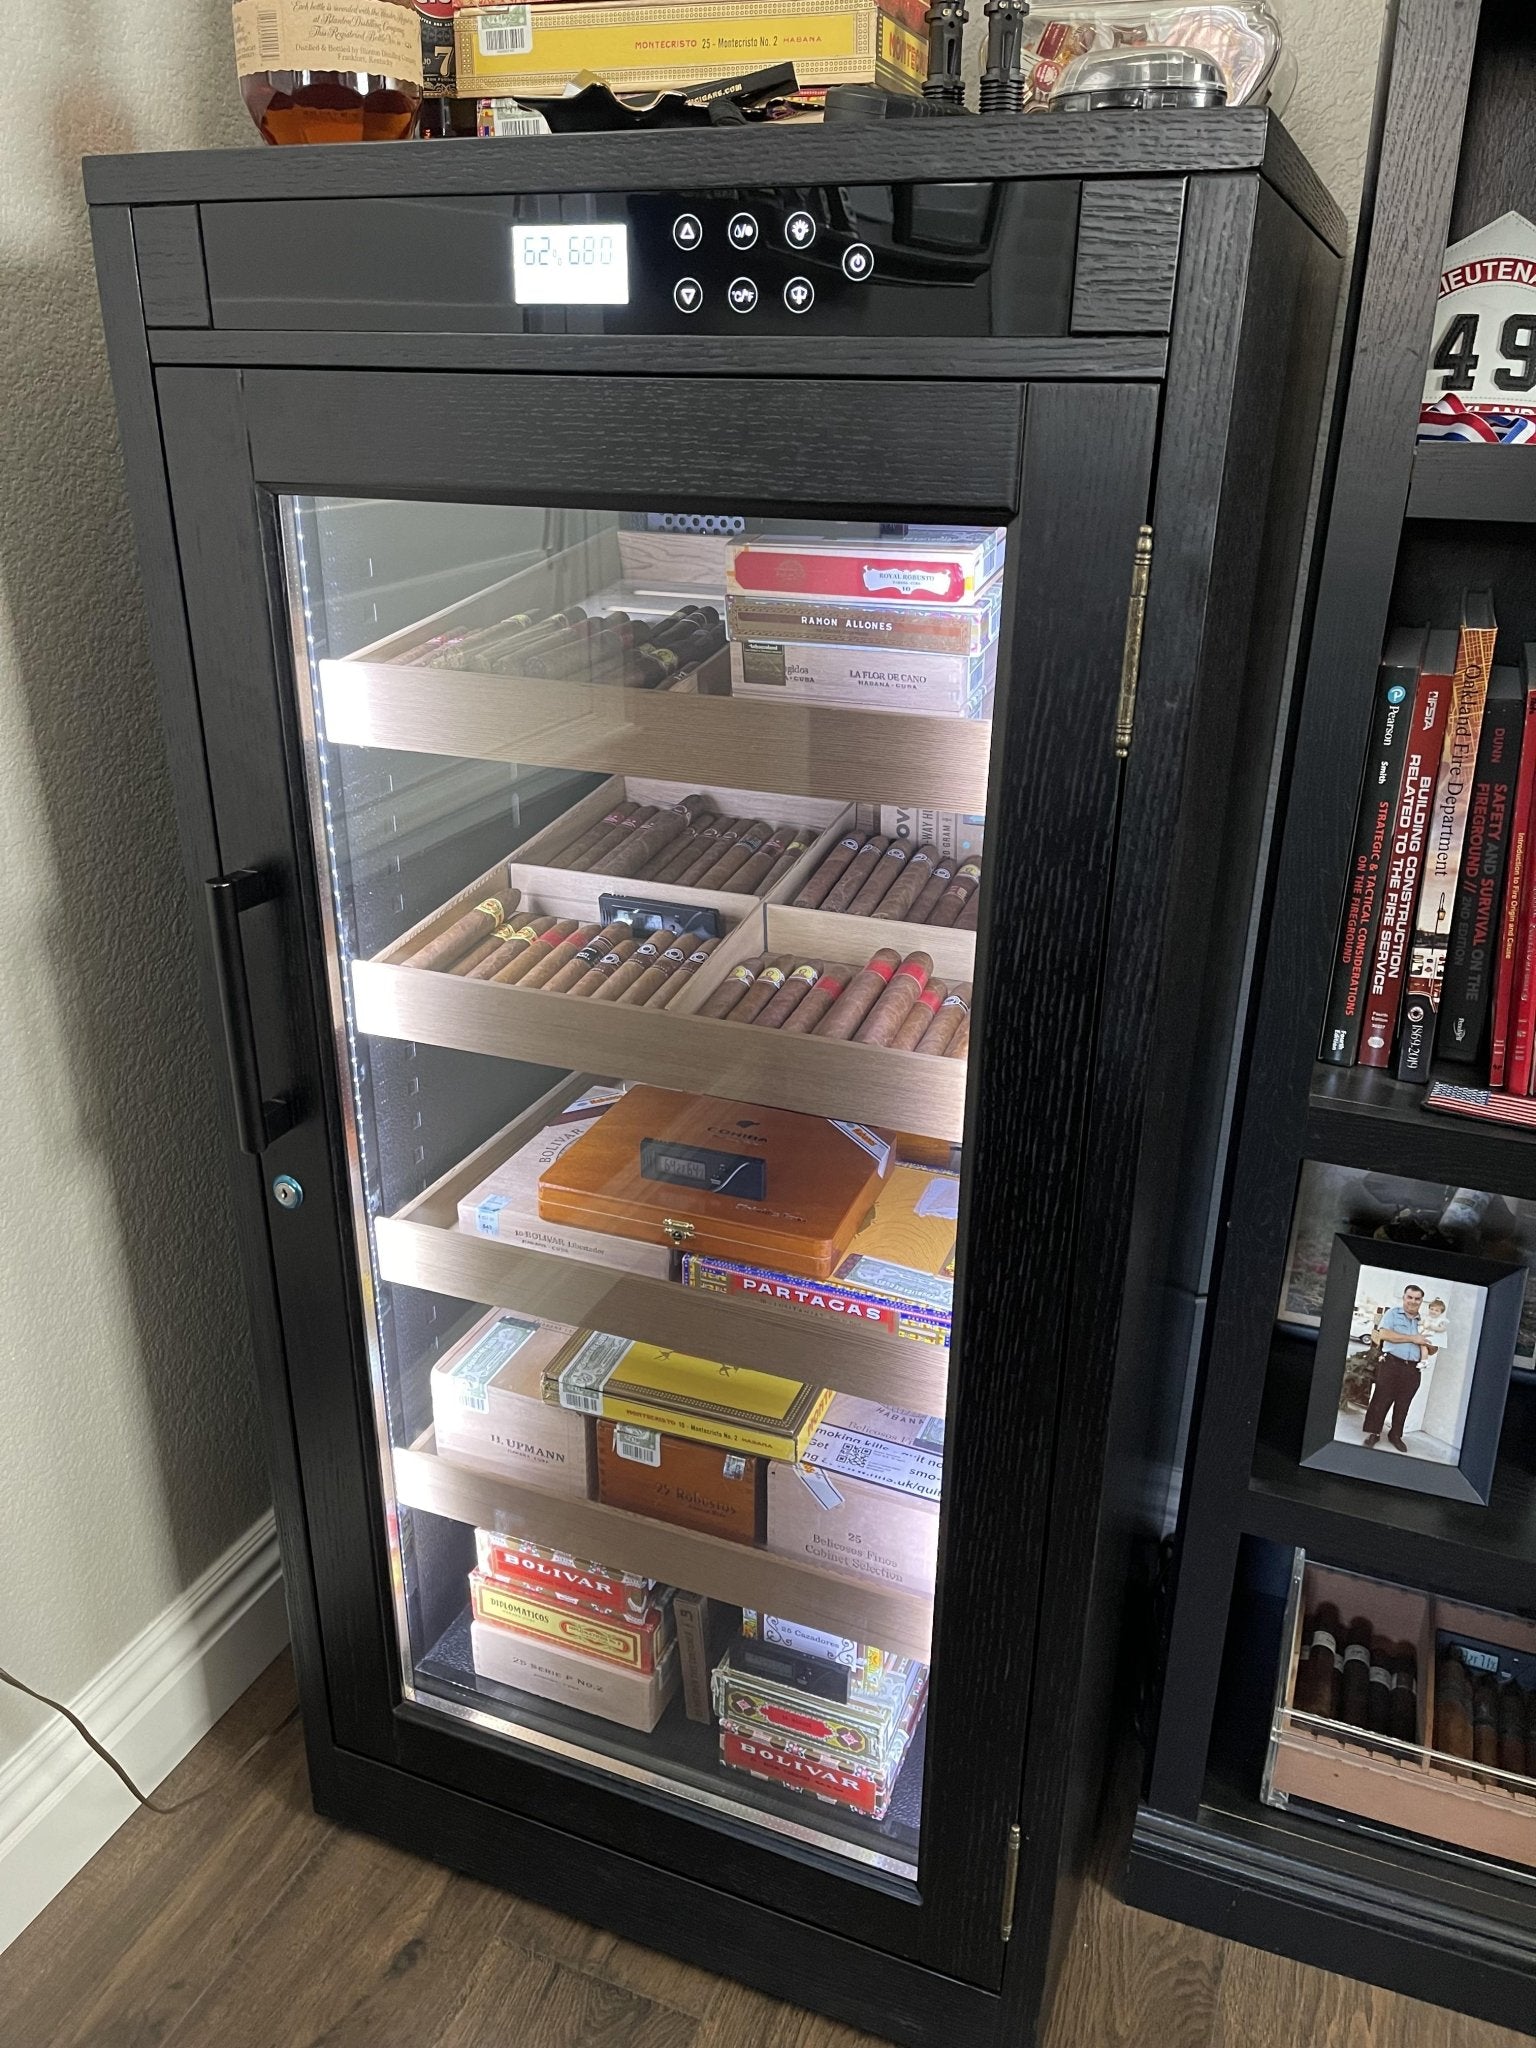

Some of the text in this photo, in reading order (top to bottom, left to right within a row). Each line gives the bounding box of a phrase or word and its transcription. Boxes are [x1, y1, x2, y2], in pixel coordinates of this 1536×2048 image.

[635, 36, 822, 49] MONTECRISTO 25 Montecristo No. 2 HABANA
[434, 46, 454, 77] 7
[801, 616, 892, 631] RAMON ALLONES
[850, 670, 861, 679] LA
[863, 670, 885, 681] FLOR
[888, 673, 900, 682] DE
[900, 674, 927, 683] CANO
[858, 680, 890, 688] HABANA
[1383, 705, 1399, 746] Pearson
[1491, 727, 1506, 764] DUNN
[1378, 761, 1388, 784] Smith
[1435, 664, 1482, 877] Oakland Fire Department
[1370, 801, 1389, 860] STRATEGIC
[1465, 783, 1490, 878] FIREGROUND
[1514, 832, 1525, 876] Introduction
[1372, 754, 1422, 996] RELATED TO THE FIRE SERVICE
[1388, 776, 1432, 978] BUILDING CONSTRUCTION
[1360, 874, 1376, 924] TACTICAL
[1460, 896, 1473, 917] 2ND
[1465, 783, 1508, 1001] SAFETY AND SURVIVAL ON THE
[1512, 885, 1520, 900] Fire
[1343, 855, 1367, 964] ON THE FIREGROUND
[1508, 900, 1518, 922] Origin
[1454, 920, 1469, 966] EDITION
[1505, 938, 1513, 959] Cause
[1345, 928, 1368, 1016] CONSIDERATIONS
[539, 1127, 584, 1164] BOLIVAR
[707, 1126, 768, 1143] COHIBA
[525, 1231, 565, 1247] BOLIVAR
[743, 1277, 880, 1320] PARTAGAS
[690, 1423, 723, 1438] Montecristo
[723, 1432, 732, 1441] No.
[808, 1438, 829, 1450] Get
[506, 1438, 565, 1462] UPMANN
[813, 1533, 898, 1568] Belicosos Finos
[848, 1532, 862, 1544] 25
[503, 1552, 613, 1595] BOLIVAR
[805, 1544, 903, 1582] Cabinet Selection
[490, 1597, 550, 1623] DIPLOMATICOS
[781, 1626, 840, 1649] 25 Cazadores
[530, 1663, 560, 1677] SERIE
[740, 1741, 860, 1791] BOLIVAR
